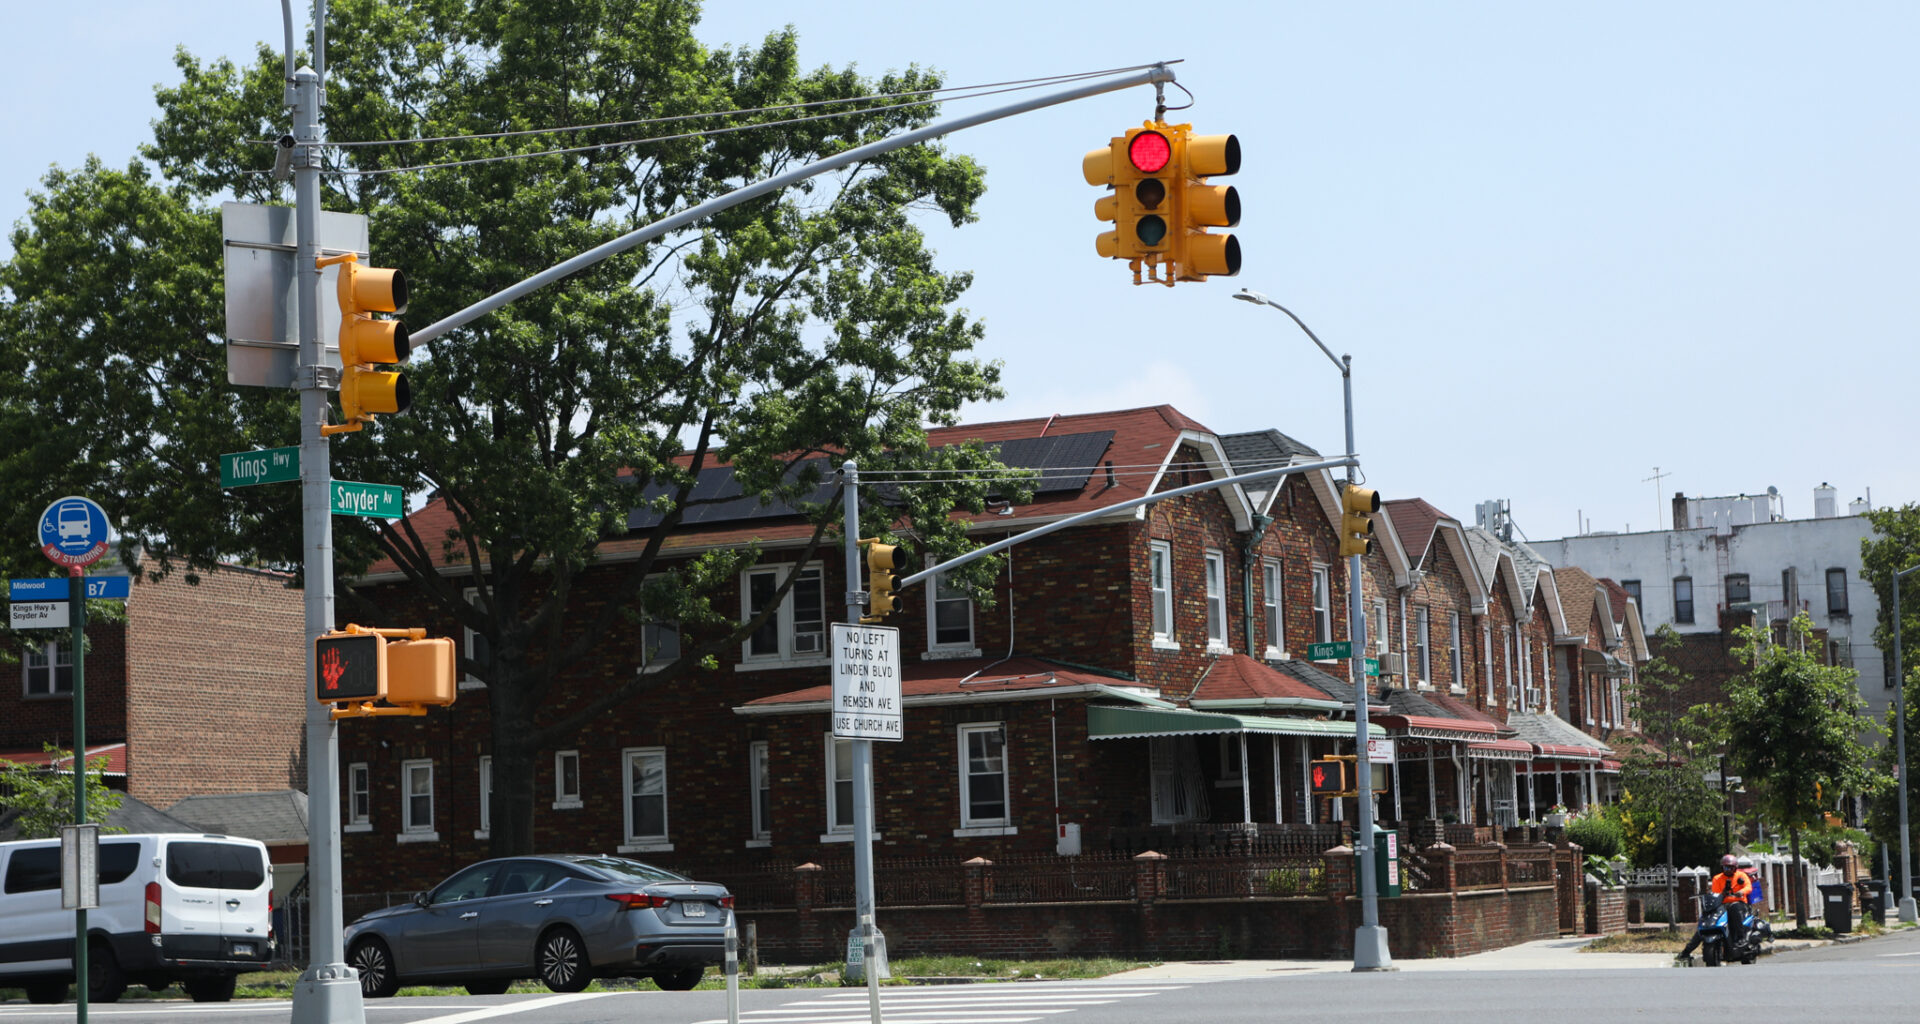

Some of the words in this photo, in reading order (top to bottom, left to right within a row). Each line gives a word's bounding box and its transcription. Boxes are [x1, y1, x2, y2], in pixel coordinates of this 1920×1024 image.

[232, 456, 268, 483] Kings
[273, 452, 290, 468] Hwy
[337, 485, 379, 514] Snyder
[383, 490, 392, 505] Av
[48, 547, 61, 560] NO
[62, 545, 104, 564] STANDING
[13, 582, 46, 590] Midwood
[88, 581, 107, 596] B7
[13, 604, 33, 612] Kings
[34, 604, 49, 612] Hwy
[13, 612, 38, 620] Snyder
[846, 632, 859, 644] NO
[863, 633, 885, 646] LEFT
[843, 647, 873, 661] TURNS
[878, 650, 888, 662] AT
[1313, 645, 1334, 658] Kings
[840, 664, 869, 677] LINDEN
[872, 666, 893, 678] BLVD
[859, 681, 876, 693] AND
[842, 695, 874, 709] REMSEN
[877, 698, 892, 710] AVE
[836, 718, 850, 730] USE
[853, 719, 883, 732] CHURCH
[886, 721, 899, 733] AVE
